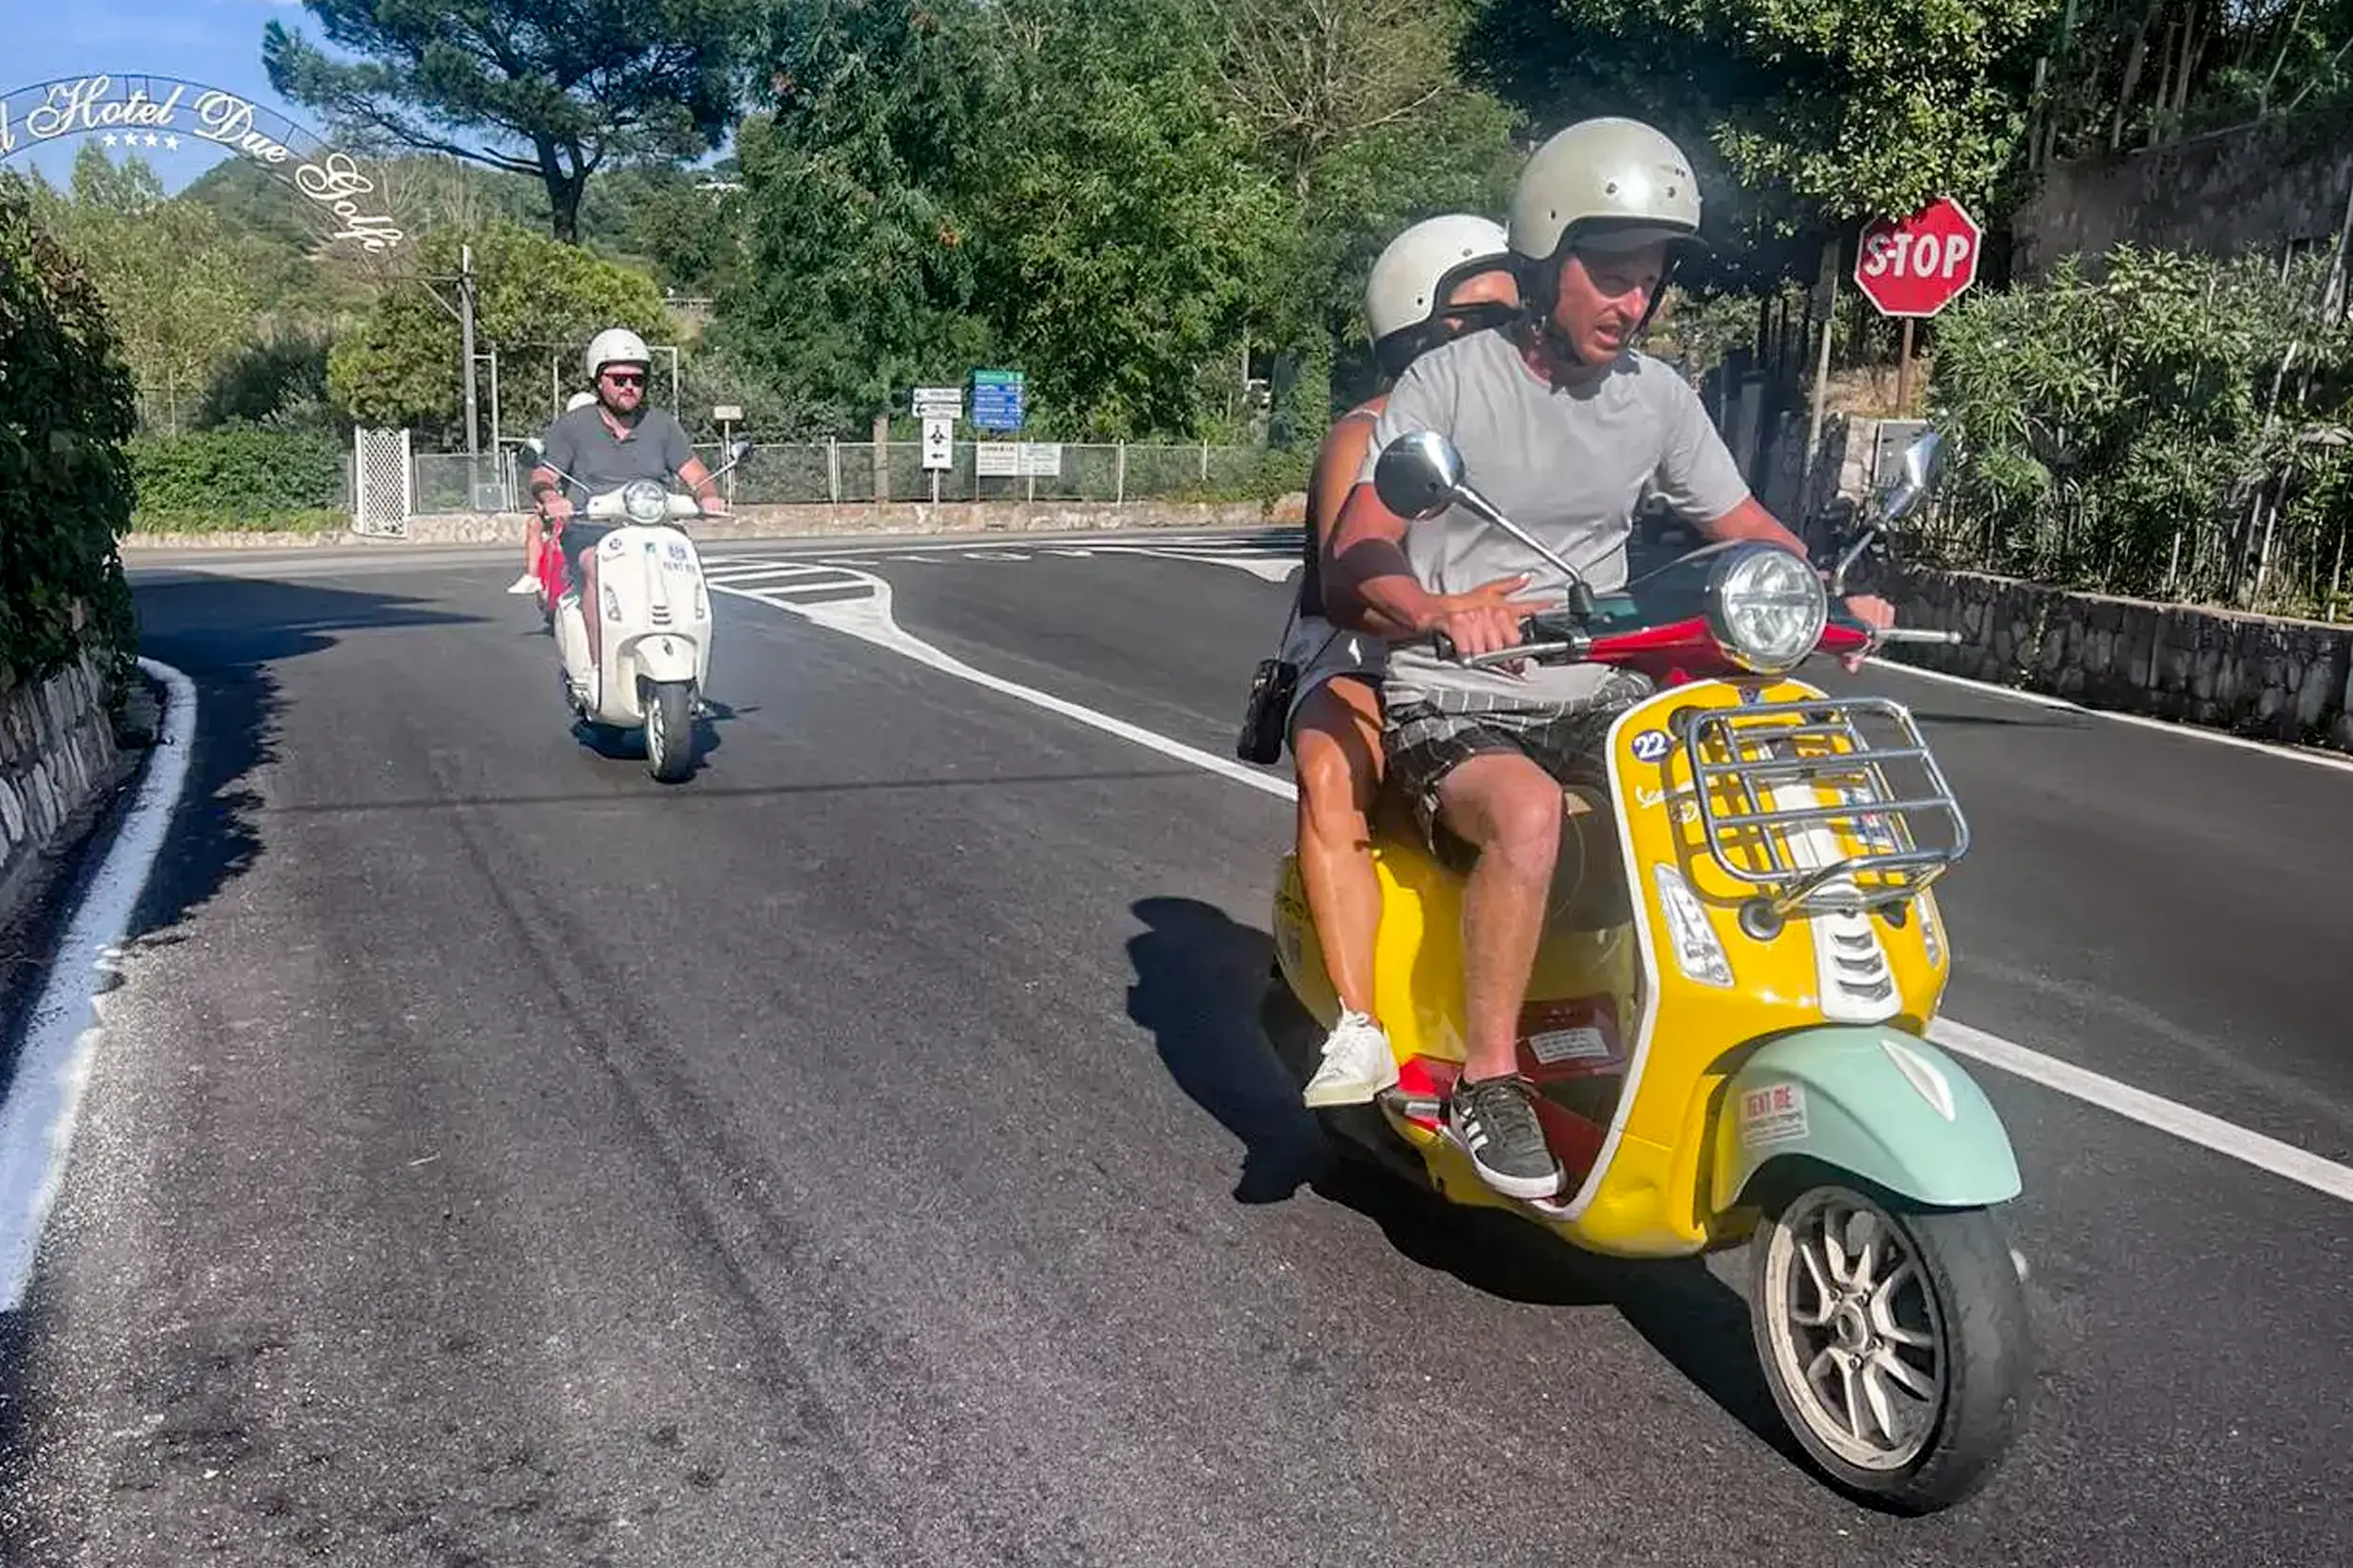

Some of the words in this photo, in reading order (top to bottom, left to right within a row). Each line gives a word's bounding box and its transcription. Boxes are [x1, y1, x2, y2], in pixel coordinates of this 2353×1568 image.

[27, 75, 185, 138] Hotel
[194, 90, 287, 163] Due
[1863, 232, 1970, 279] STOP
[1634, 731, 1668, 759] 22
